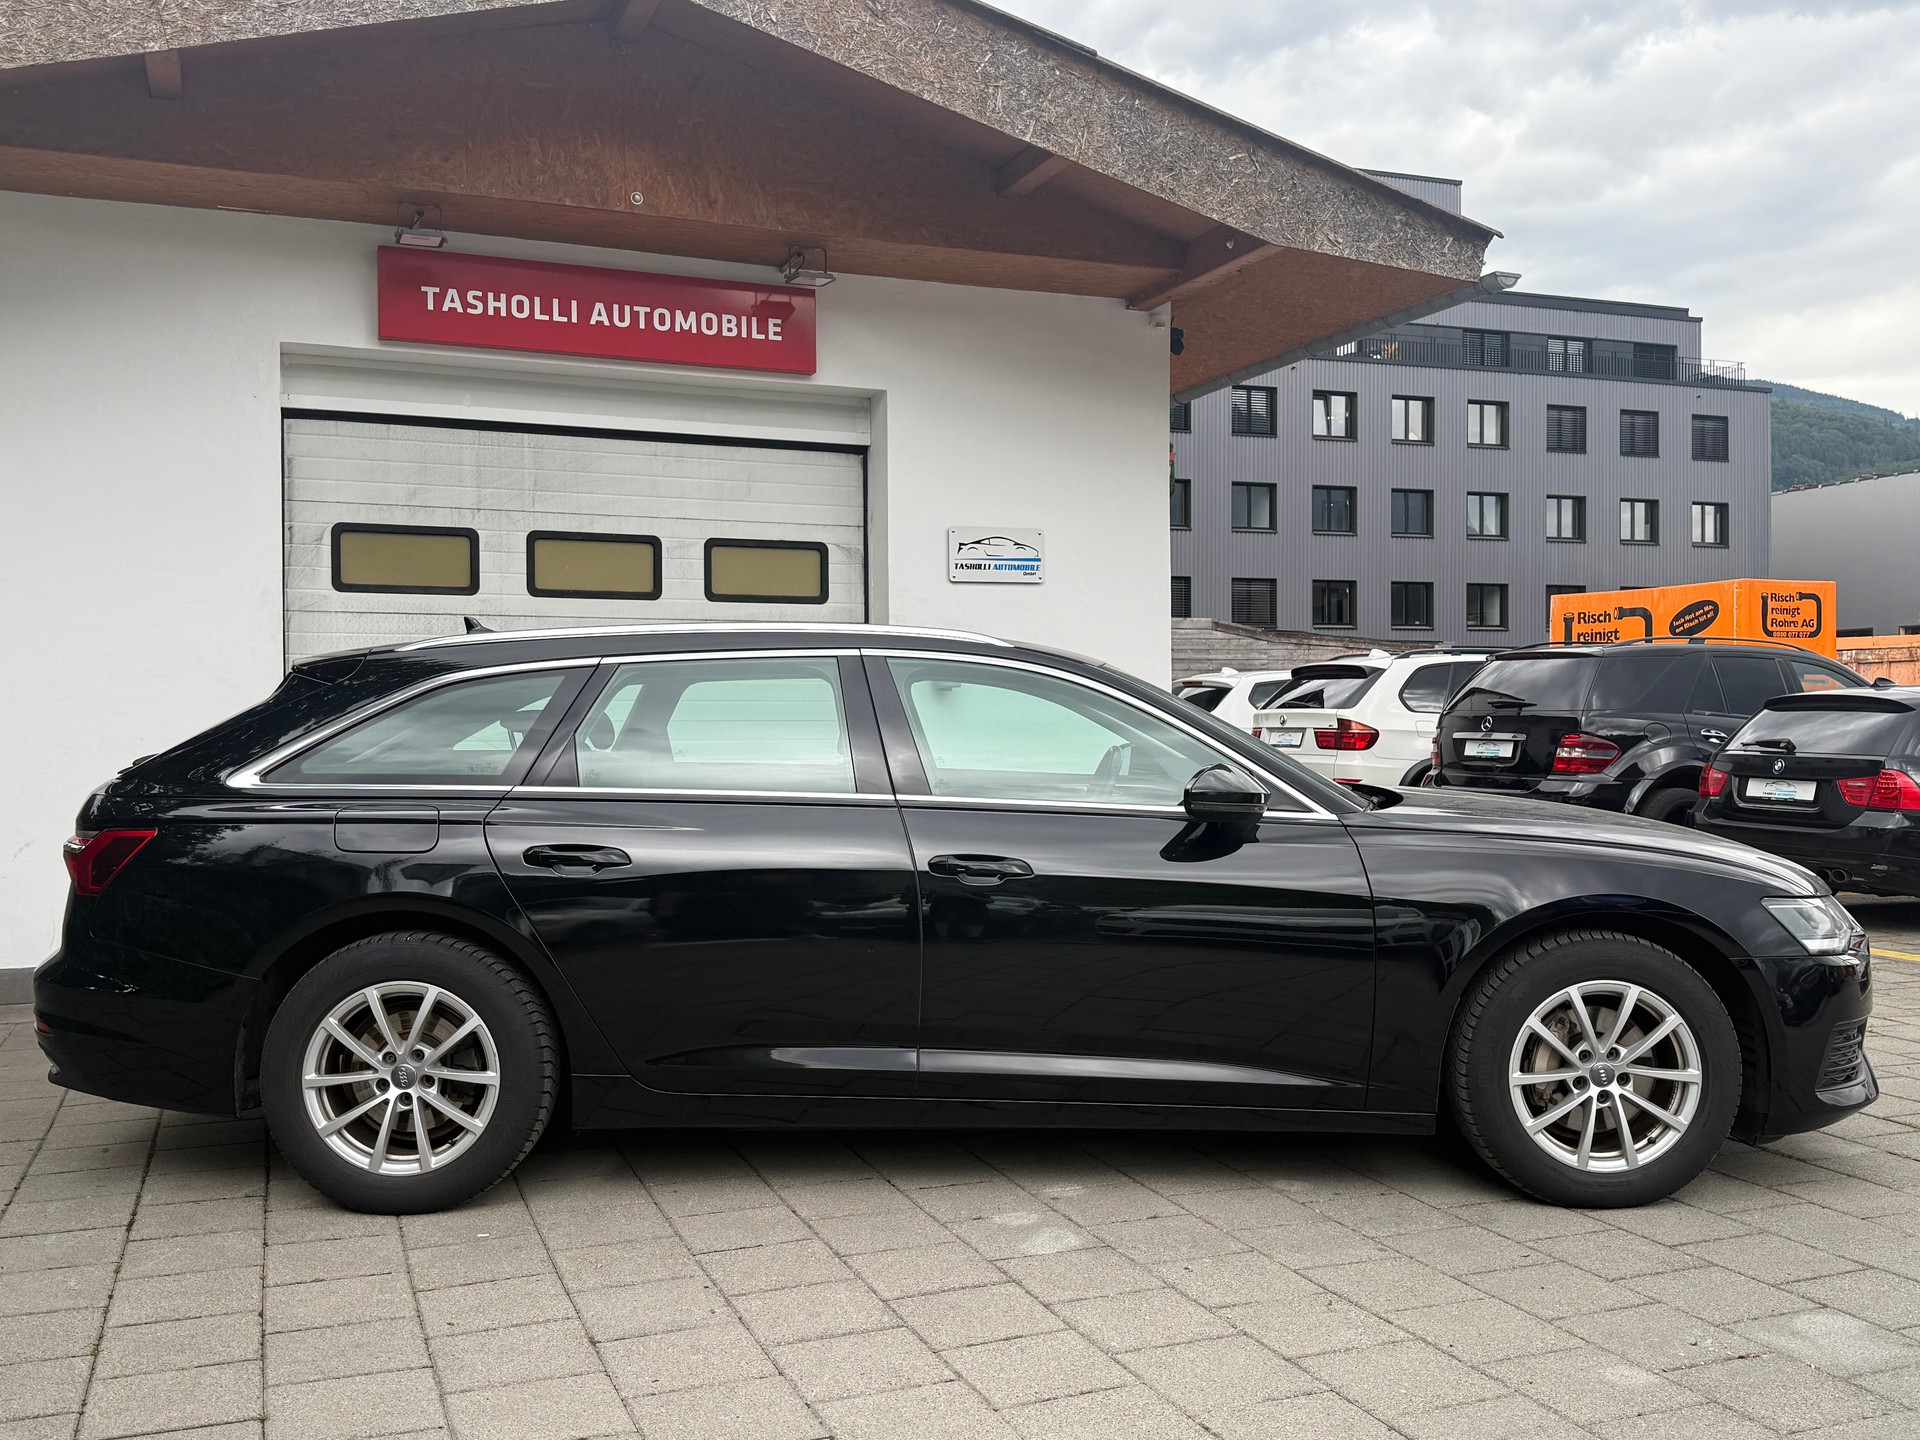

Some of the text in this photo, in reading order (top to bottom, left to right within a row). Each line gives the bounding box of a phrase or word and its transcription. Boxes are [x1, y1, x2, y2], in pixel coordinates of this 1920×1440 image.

[420, 285, 782, 341] TASHOLLI AUTOMOBILE
[954, 562, 1041, 572] TASHOLLI AUTOMOBILE
[1770, 592, 1795, 602] Risch
[1577, 610, 1612, 624] Risch
[1771, 605, 1801, 618] reinigt
[1770, 618, 1815, 628] Rohre AG
[1577, 627, 1620, 643] reinigt
